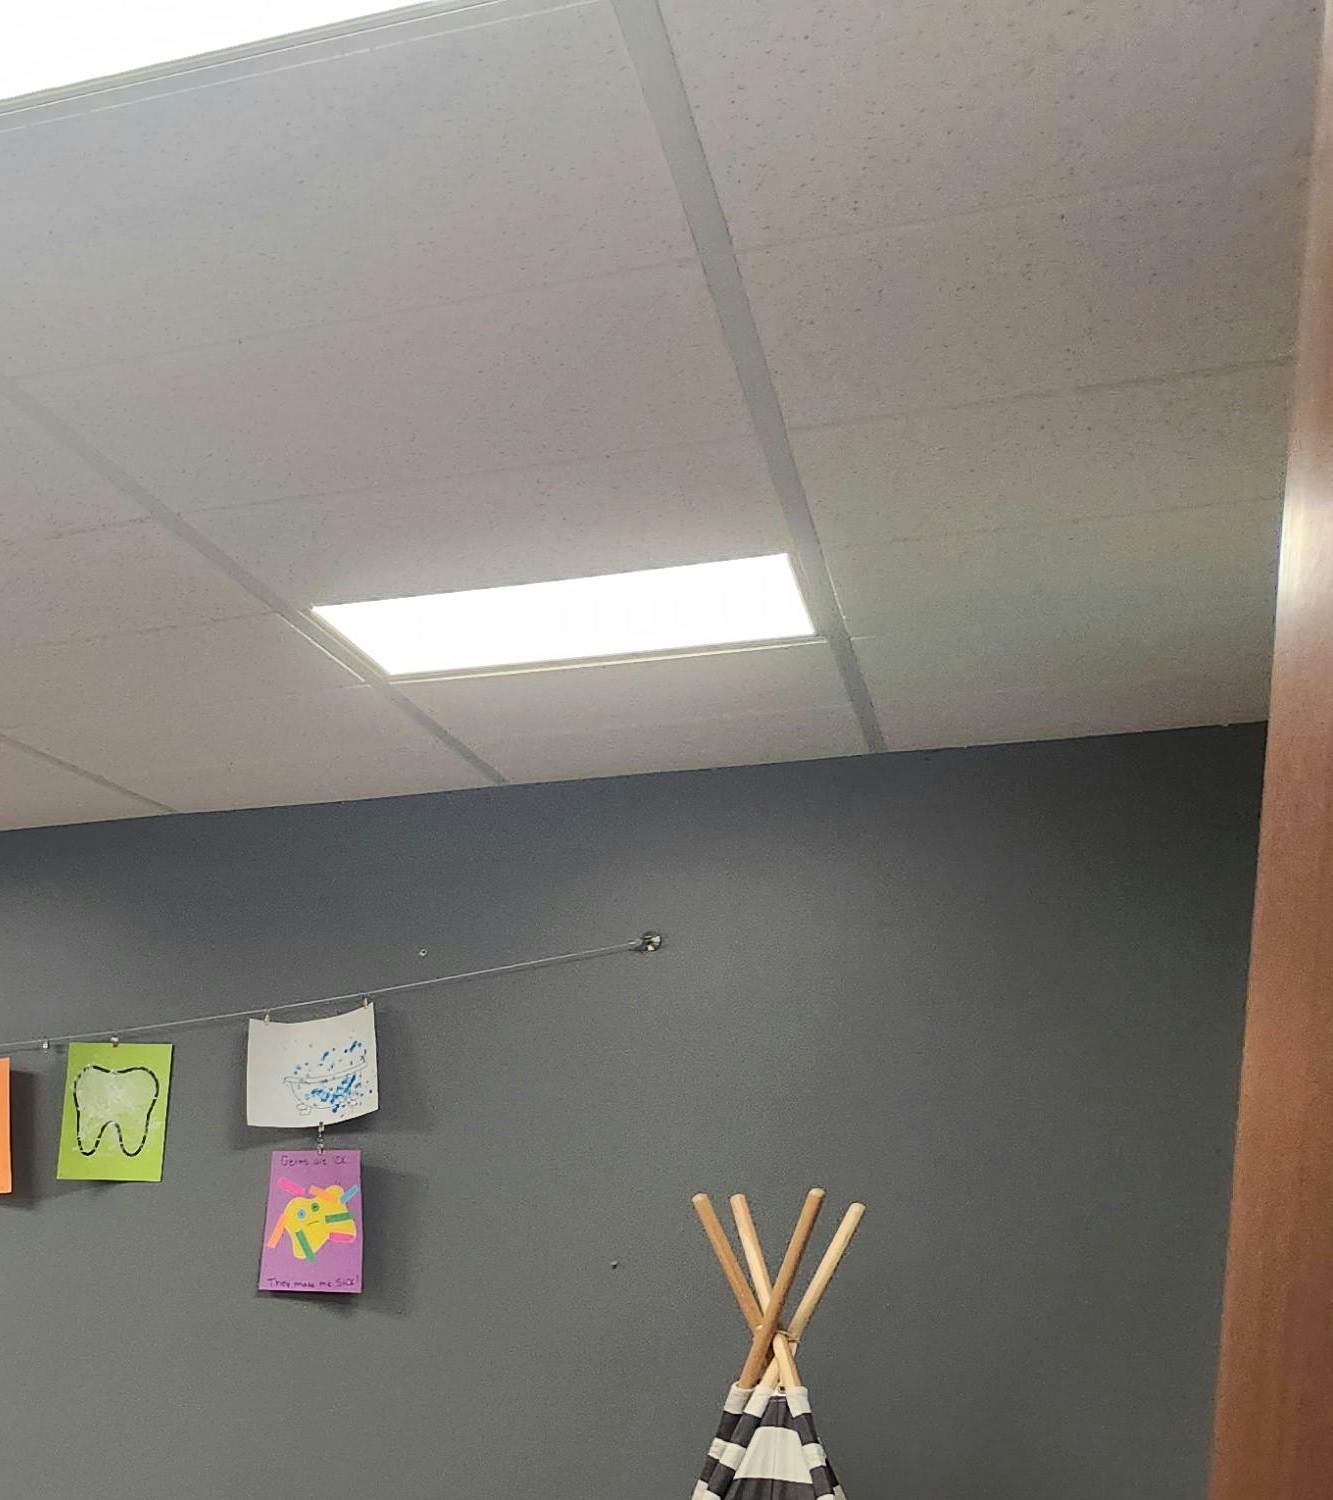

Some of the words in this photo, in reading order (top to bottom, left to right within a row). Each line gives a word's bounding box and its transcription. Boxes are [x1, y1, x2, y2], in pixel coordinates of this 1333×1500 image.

[280, 1155, 309, 1166] Germs
[313, 1158, 327, 1166] are
[267, 1277, 290, 1288] They
